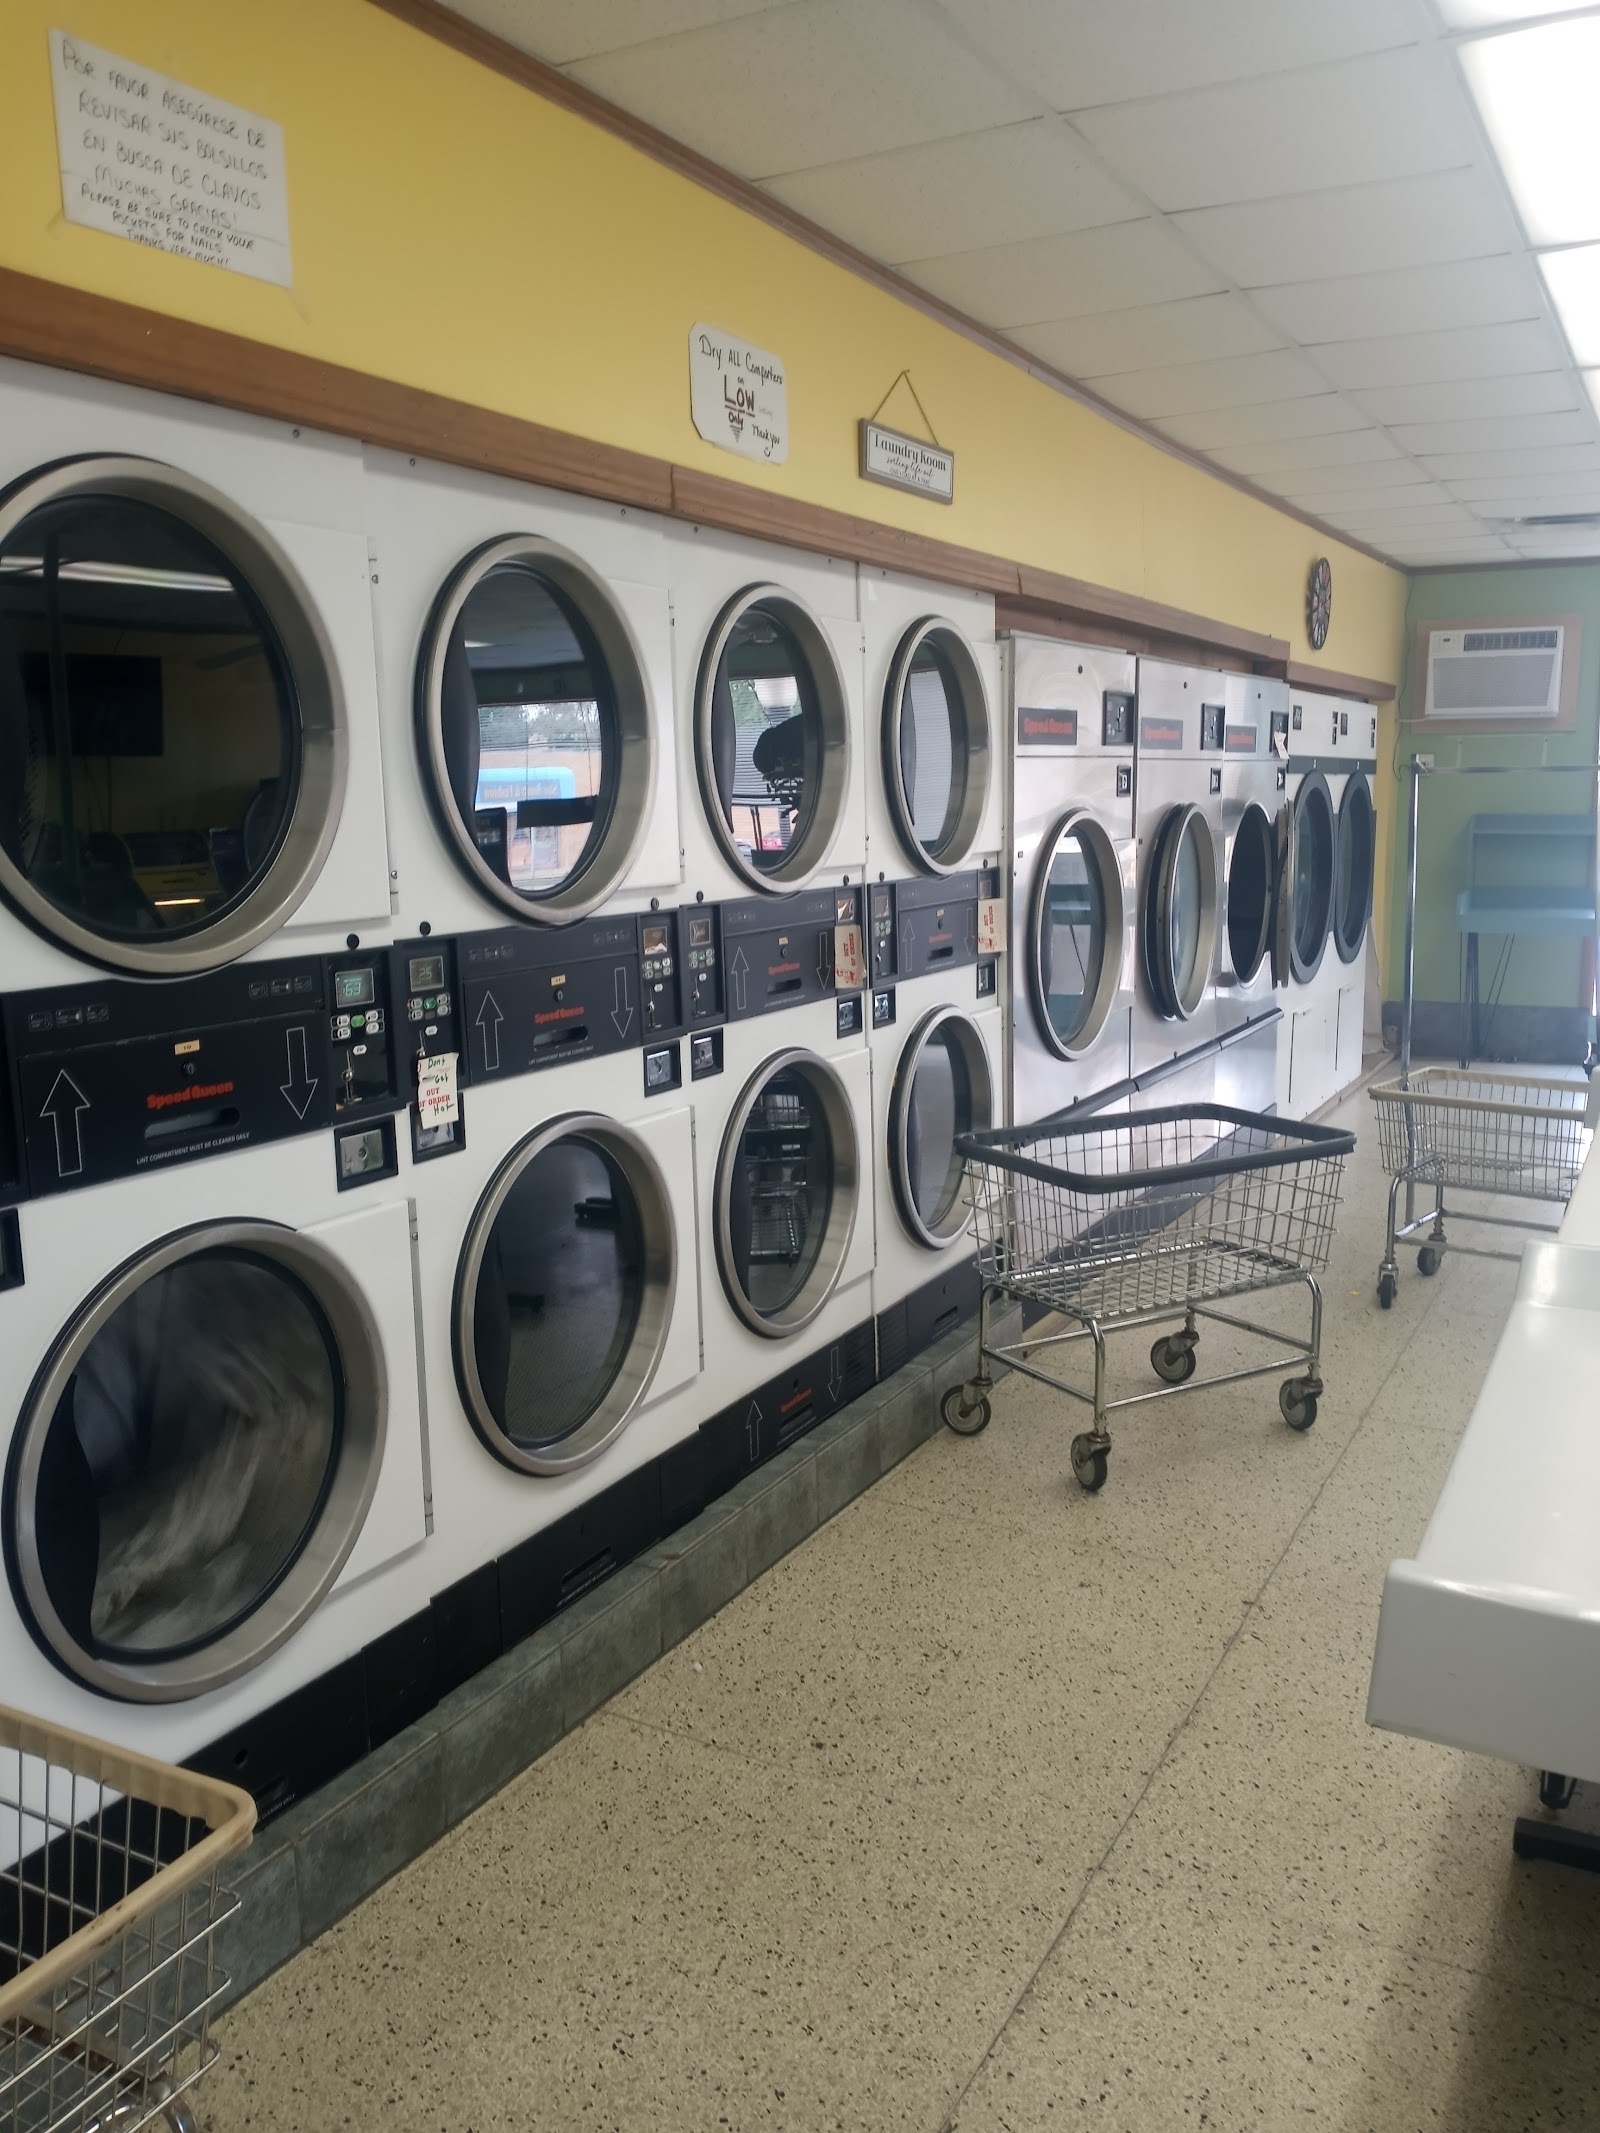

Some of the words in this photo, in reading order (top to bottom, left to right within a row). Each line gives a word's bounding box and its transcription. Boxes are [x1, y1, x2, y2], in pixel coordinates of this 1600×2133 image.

[62, 38, 96, 78] POR
[109, 70, 149, 99] FAVOR
[247, 128, 266, 148] DE
[79, 88, 151, 136] REVISAR
[158, 122, 189, 150] SUS
[83, 128, 105, 152] EN
[116, 140, 162, 175] BUSCA
[171, 164, 193, 188] DE
[201, 173, 261, 210] CLAVOS
[81, 182, 120, 209] PLEASE
[127, 202, 139, 213] BE
[145, 207, 171, 225] SURE
[178, 217, 189, 230] TO
[193, 222, 223, 239] CHECK
[226, 234, 254, 251] YOUR
[166, 227, 184, 241] FOR
[191, 235, 222, 253] NAILS
[699, 334, 722, 371] Dry
[724, 374, 755, 412] LOW
[875, 433, 919, 464] Laundry
[920, 450, 946, 471] Room
[146, 1087, 191, 1109] Speed
[191, 1081, 234, 1098] Queen
[426, 1087, 440, 1096] OUT
[428, 1095, 450, 1106] ORDER
